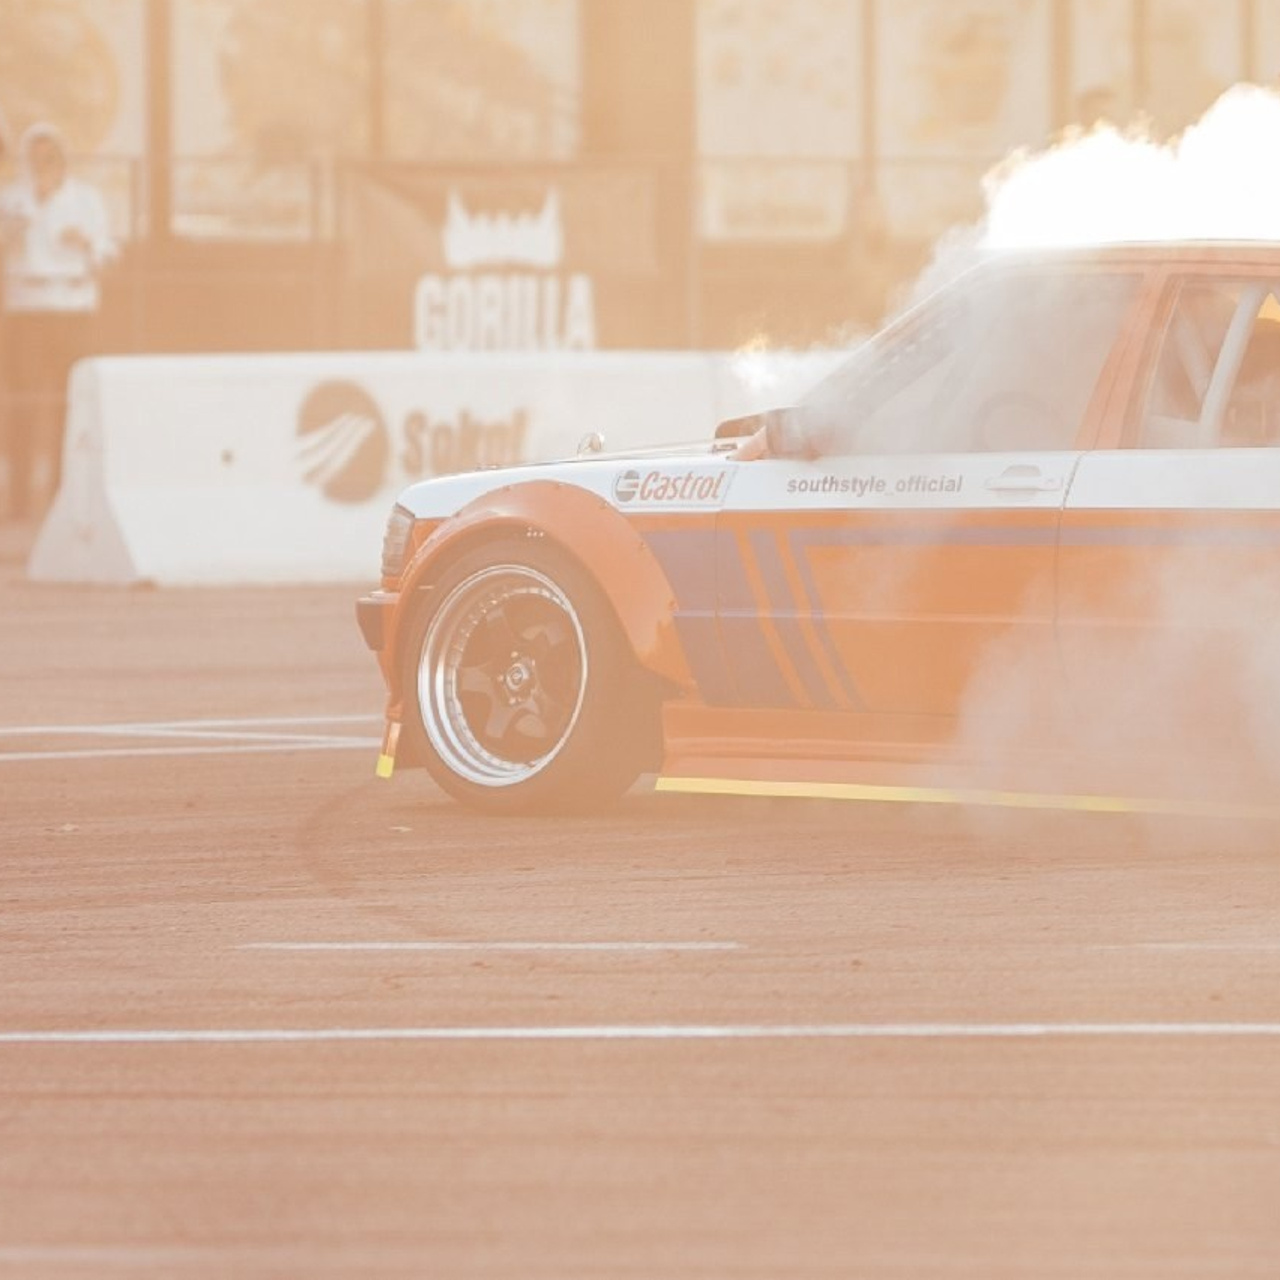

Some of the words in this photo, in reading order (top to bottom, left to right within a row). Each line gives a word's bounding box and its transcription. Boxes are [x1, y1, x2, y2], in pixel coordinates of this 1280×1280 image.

[415, 274, 594, 352] GORILLA
[640, 470, 727, 501] Castrol
[786, 475, 964, 498] southstyle_official
